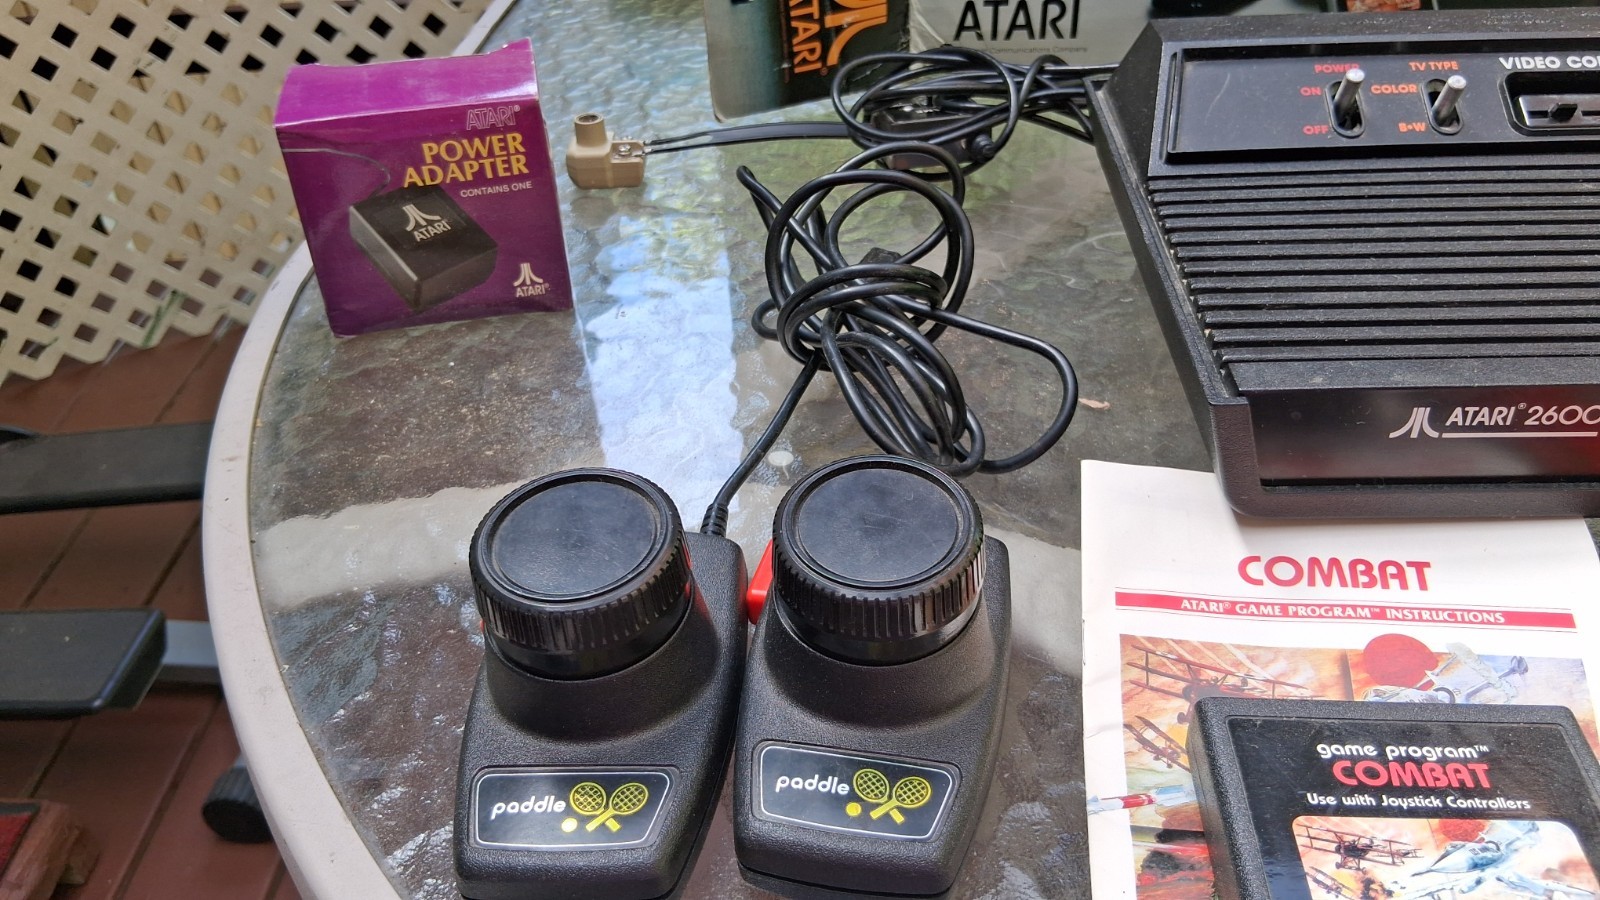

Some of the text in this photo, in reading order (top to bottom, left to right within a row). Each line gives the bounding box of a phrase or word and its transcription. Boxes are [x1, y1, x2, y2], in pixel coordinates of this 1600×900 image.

[953, 0, 1080, 41] ATARI
[1408, 60, 1459, 71] TV TYPE
[1498, 55, 1600, 69] VIDEO CO
[1300, 87, 1322, 96] ON
[1370, 84, 1417, 94] COLOR
[1303, 125, 1329, 135] OFF
[422, 133, 526, 163] POWER
[404, 154, 529, 188] ADAPTER
[460, 181, 533, 197] CONTAINS ONE
[1524, 405, 1600, 426] 2600
[1238, 555, 1431, 592] COMBAT
[1235, 603, 1283, 617] GAME
[1386, 608, 1505, 624] INSTRUCTIONS
[1316, 743, 1378, 759] game
[775, 774, 850, 795] paddle
[1332, 760, 1491, 789] COMBAT
[491, 795, 566, 820] paddle
[1306, 793, 1530, 809] Use with Joystick Controllers
